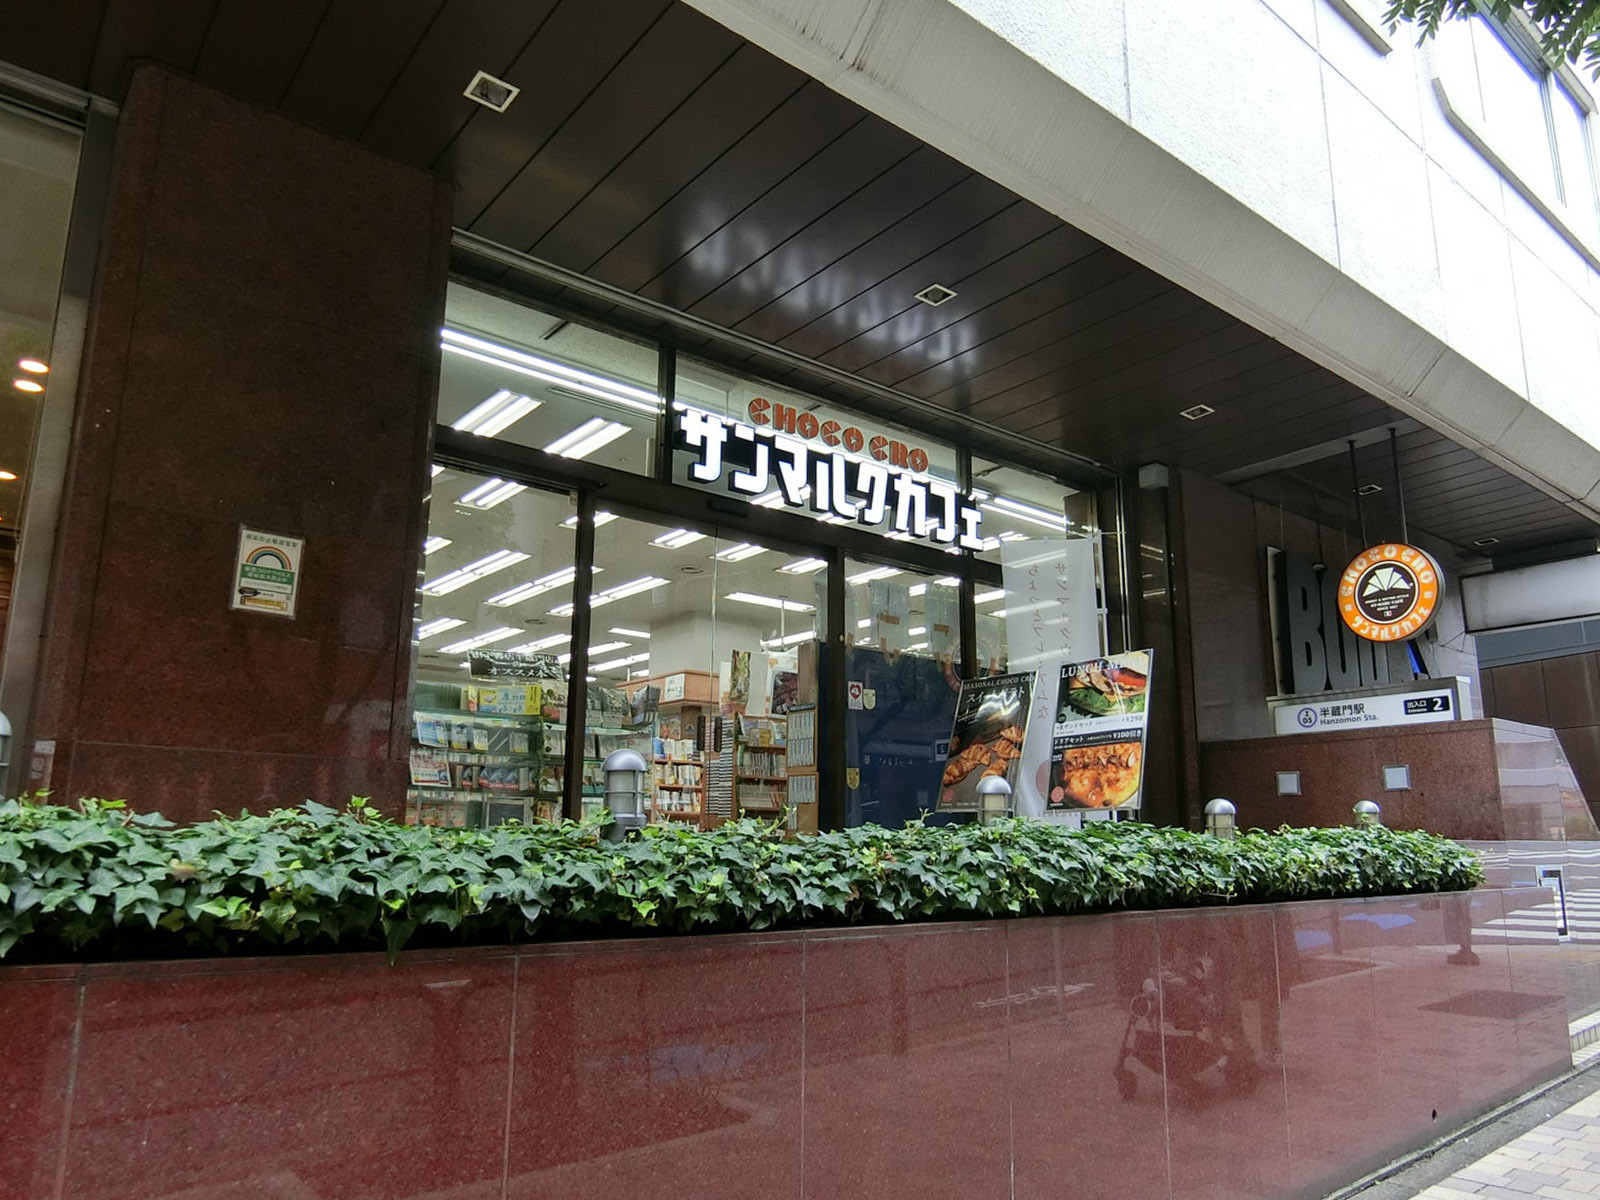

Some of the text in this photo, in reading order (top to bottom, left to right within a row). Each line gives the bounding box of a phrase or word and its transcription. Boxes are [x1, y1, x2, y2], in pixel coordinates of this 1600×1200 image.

[748, 397, 929, 473] CHOCO CRO
[679, 408, 984, 551] サンマルクカフェ
[487, 667, 549, 679] オススメ本
[1061, 660, 1104, 678] LUNCH
[964, 680, 995, 689] SEASONAL
[996, 677, 1019, 686] CHOCO
[1320, 703, 1366, 718] 半蔵門駅
[1432, 697, 1444, 711] 2
[1320, 713, 1380, 726] Hanzomon Sta.
